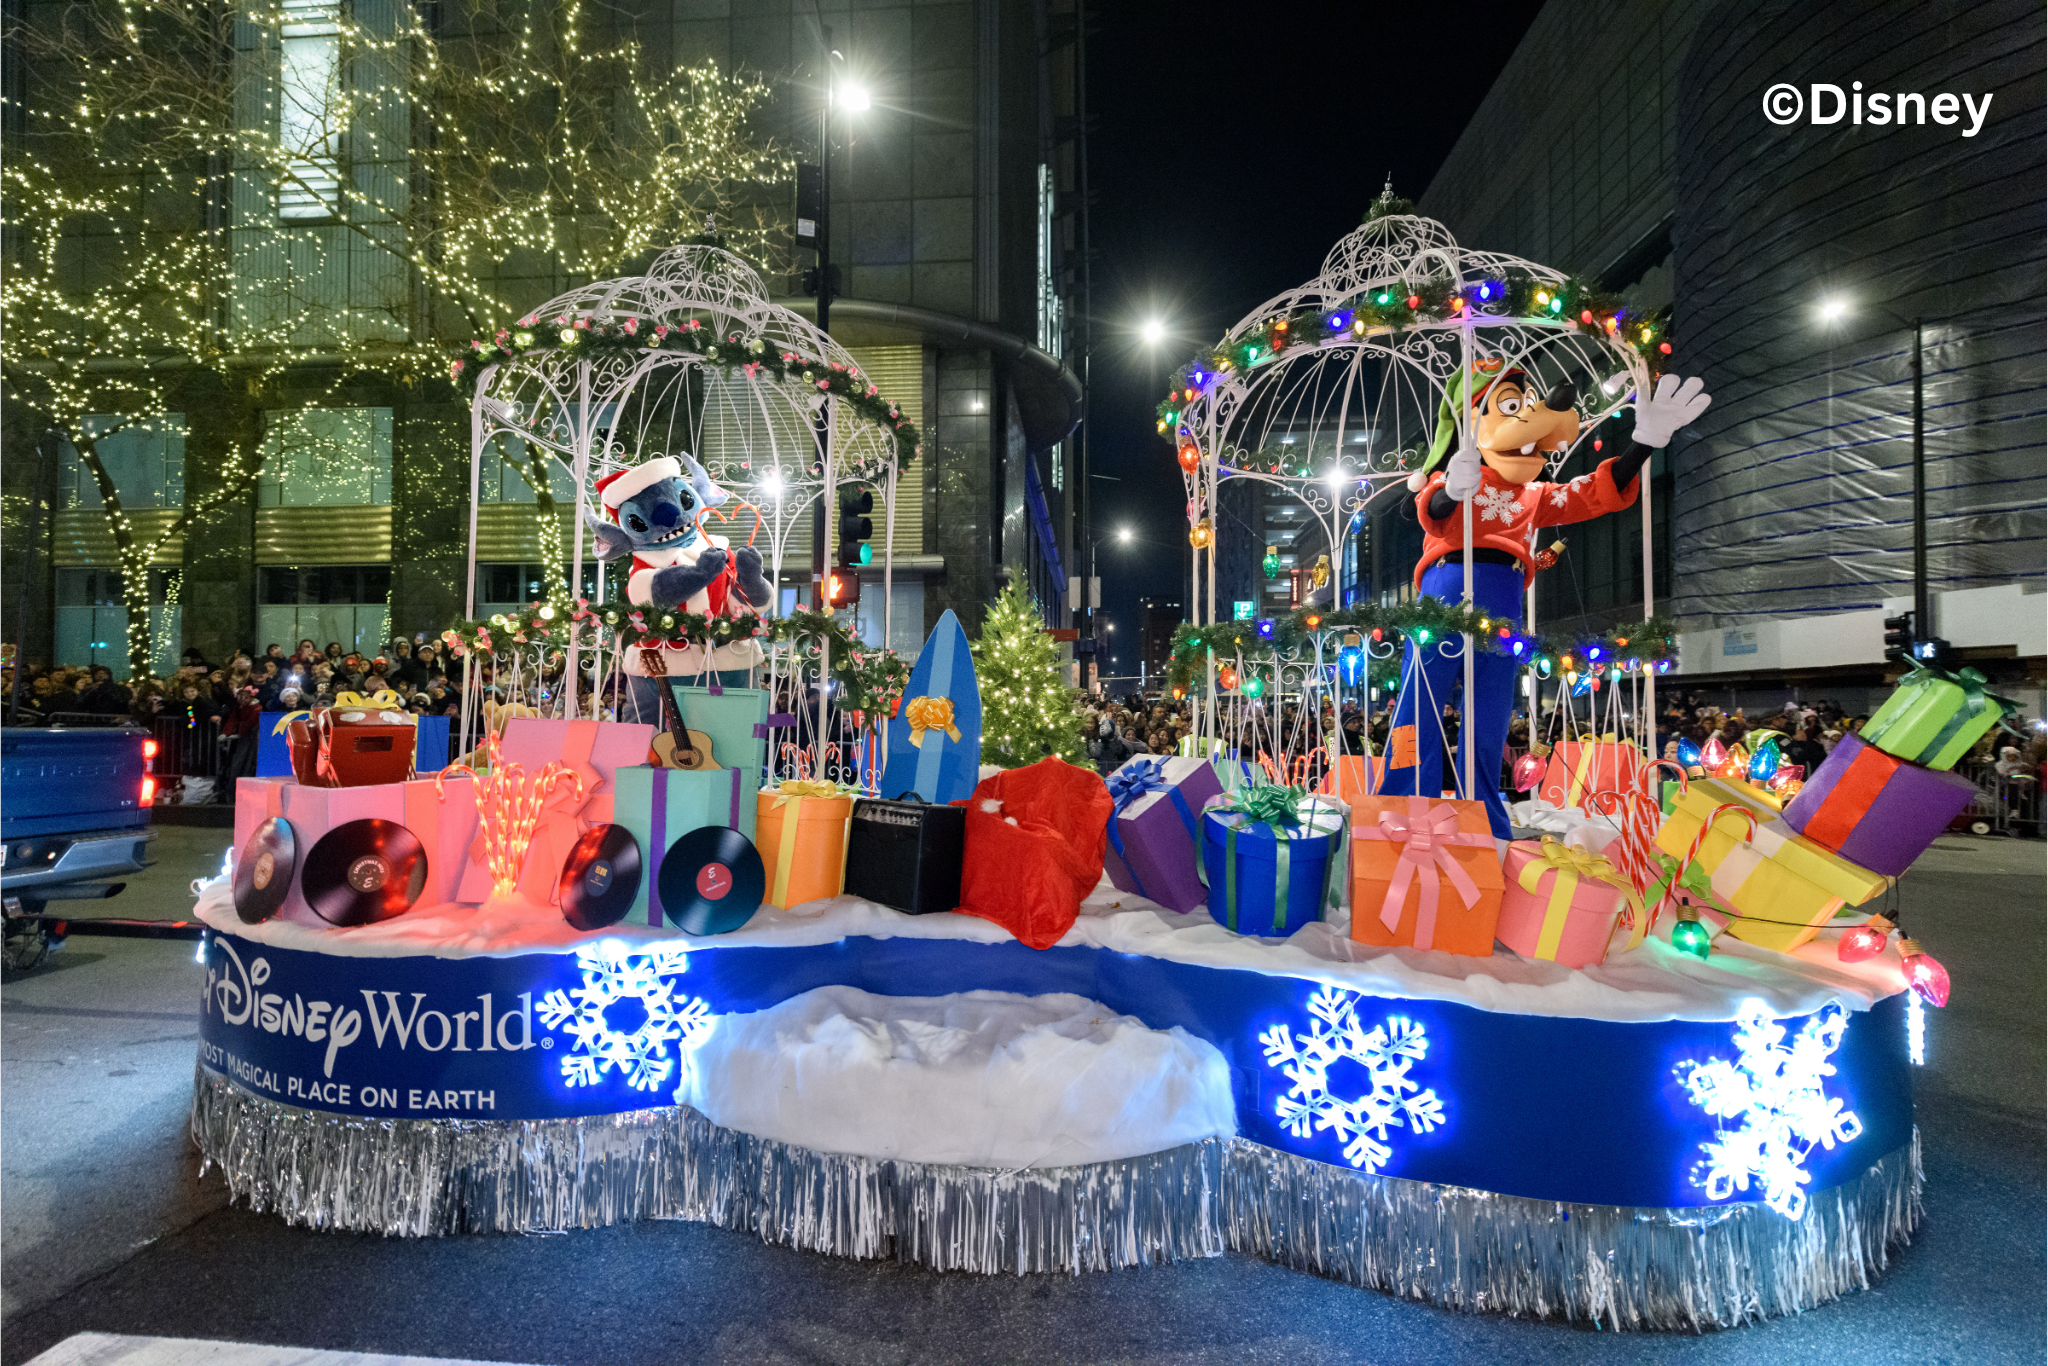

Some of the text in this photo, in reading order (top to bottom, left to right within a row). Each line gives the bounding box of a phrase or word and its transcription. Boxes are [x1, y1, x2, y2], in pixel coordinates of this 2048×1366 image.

[227, 1051, 281, 1094] MAGICAL
[287, 1075, 351, 1106] PLACE
[360, 1086, 398, 1109] ON
[409, 1089, 496, 1110] EARTH
